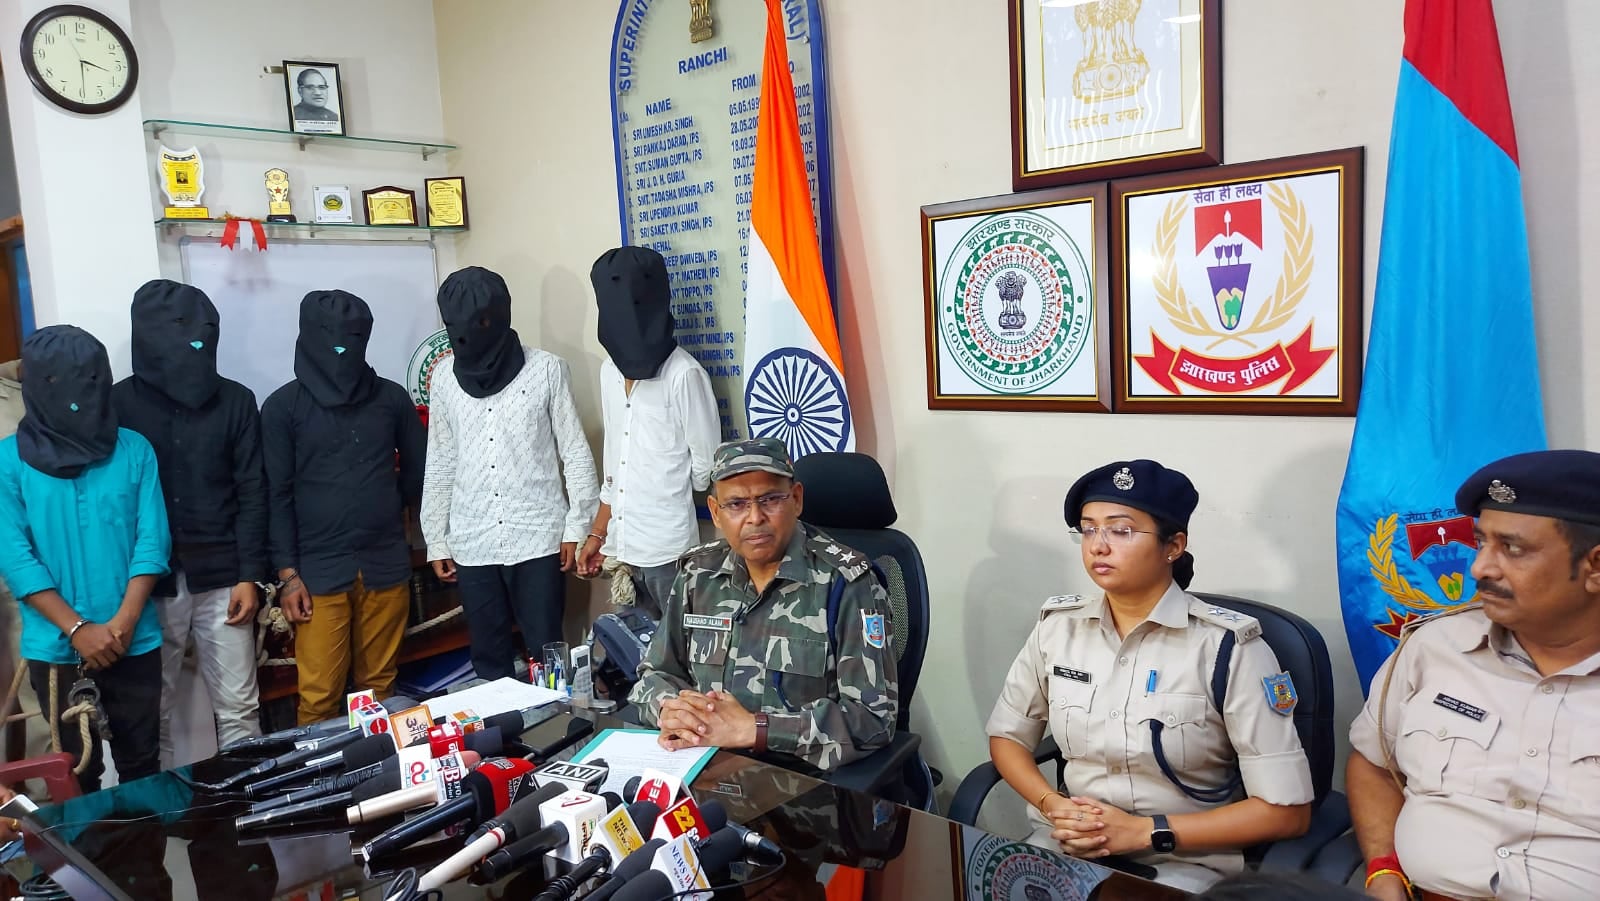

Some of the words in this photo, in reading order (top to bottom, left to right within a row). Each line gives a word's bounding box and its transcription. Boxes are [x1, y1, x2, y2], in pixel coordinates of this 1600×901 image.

[618, 0, 652, 90] SUPERINT
[678, 47, 728, 74] RANCHI
[732, 73, 757, 92] FROM
[645, 98, 672, 117] NAME
[675, 115, 694, 130] SINGH
[689, 131, 700, 144] IPS
[692, 148, 702, 161] IPS
[666, 169, 686, 184] GURIA
[704, 181, 714, 193] IPS
[1193, 188, 1215, 204] सेवा
[1219, 185, 1231, 202] ही
[1234, 183, 1263, 198] लक्ष्य
[639, 210, 649, 223] SRI
[649, 206, 676, 221] UPENDRA
[677, 201, 699, 216] KUMAR
[650, 223, 669, 237] SAKET
[702, 216, 713, 229] IPS
[965, 218, 1011, 250] झारखण्ड
[1014, 218, 1056, 242] सरकार
[664, 255, 679, 268] DEEP
[707, 250, 718, 262] IPS
[709, 266, 720, 279] IPS
[703, 284, 713, 296] IPS
[703, 300, 713, 313] IPS
[704, 316, 715, 328] IPS
[723, 331, 735, 344] IPS
[723, 348, 734, 360] IPS
[946, 322, 1009, 386] GOVERNMENT
[1011, 376, 1026, 387] OF
[1029, 314, 1084, 384] JHARKHAND
[730, 365, 741, 377] IPS
[1179, 359, 1235, 384] झारखण्ड
[1240, 355, 1281, 385] पुलिस
[551, 764, 598, 780] ANI
[671, 845, 688, 874] NEWS
